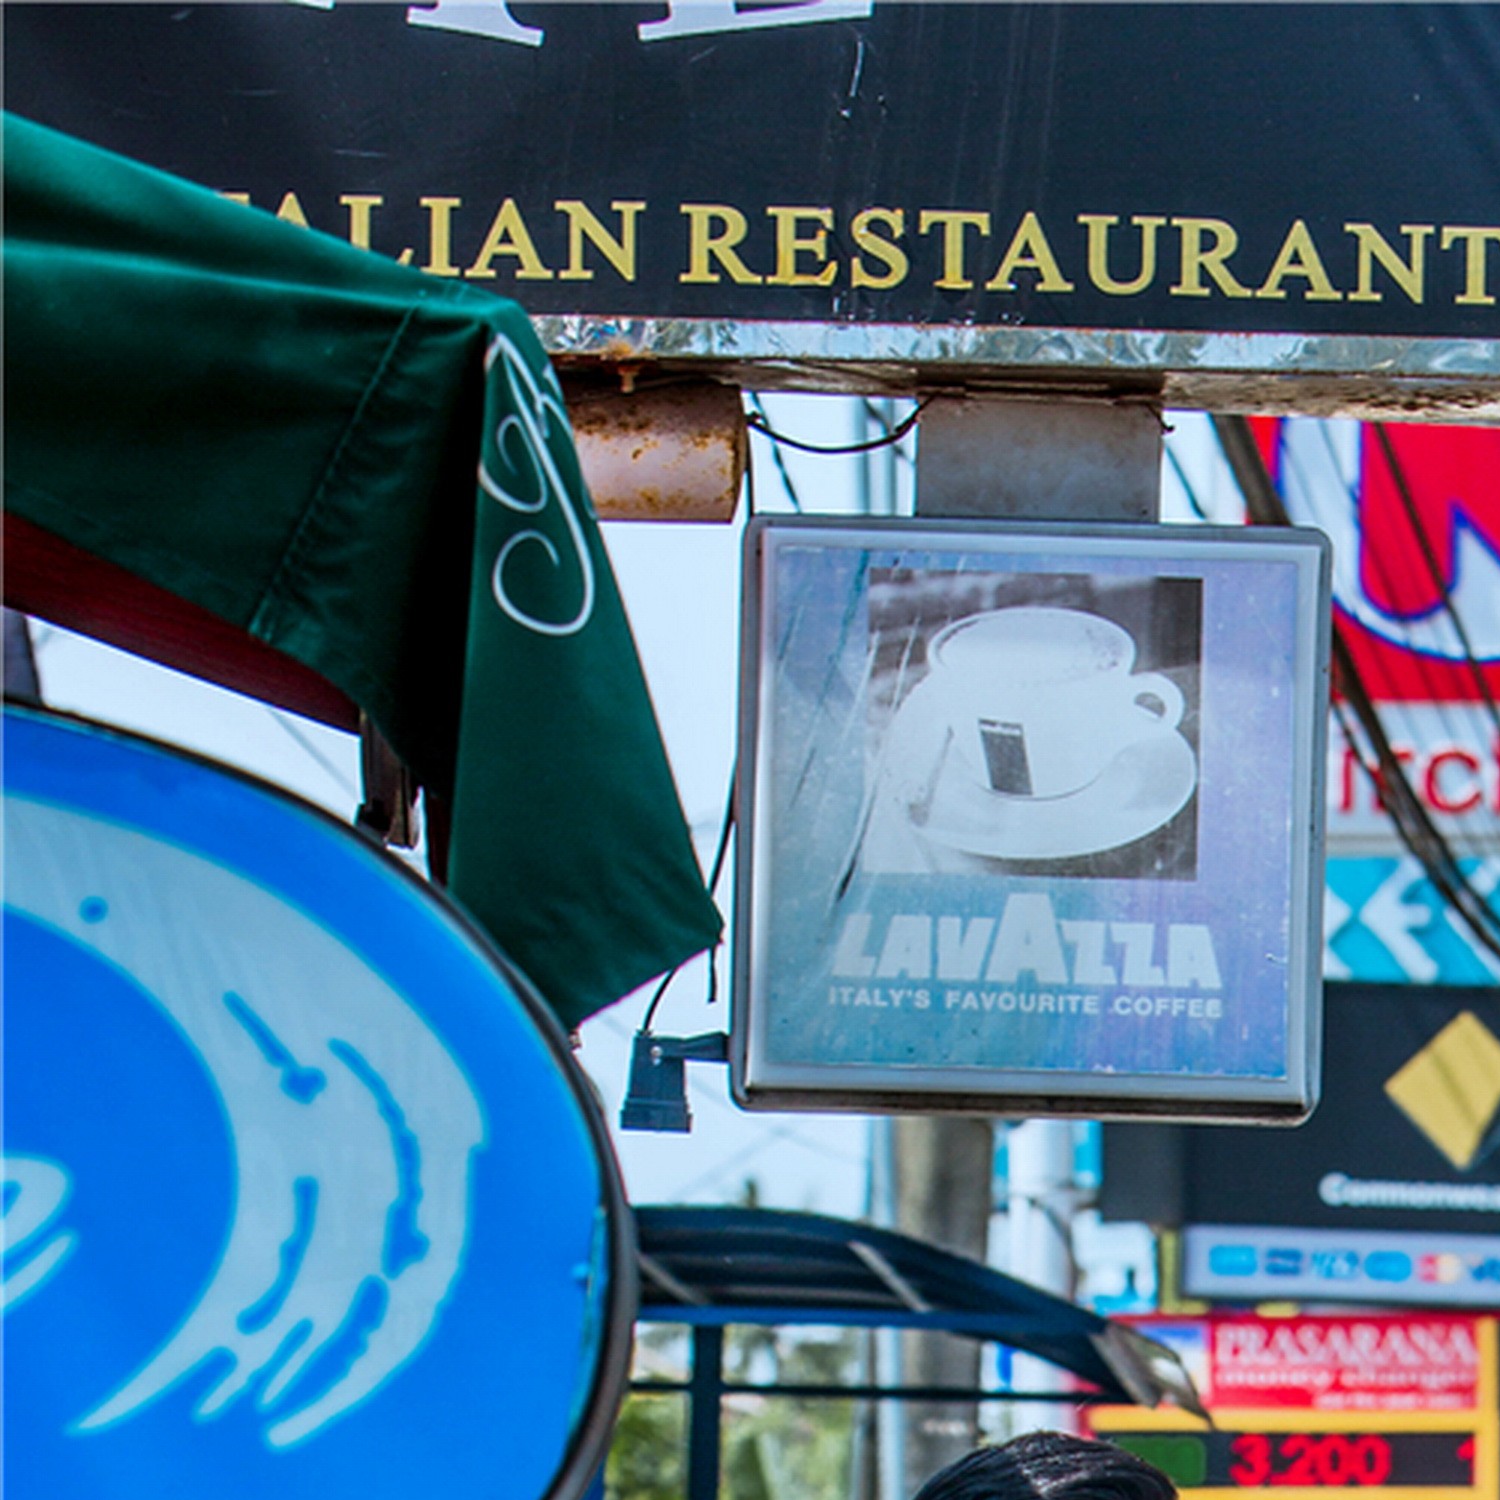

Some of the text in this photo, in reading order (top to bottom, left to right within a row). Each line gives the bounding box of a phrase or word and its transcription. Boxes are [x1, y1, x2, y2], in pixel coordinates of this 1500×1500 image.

[216, 192, 647, 282] LIAN
[830, 892, 1223, 990] LAVAZZA
[828, 984, 1222, 1019] ITALY'S FAVOURITE COFFEE
[1229, 1432, 1393, 1487] 3.200
